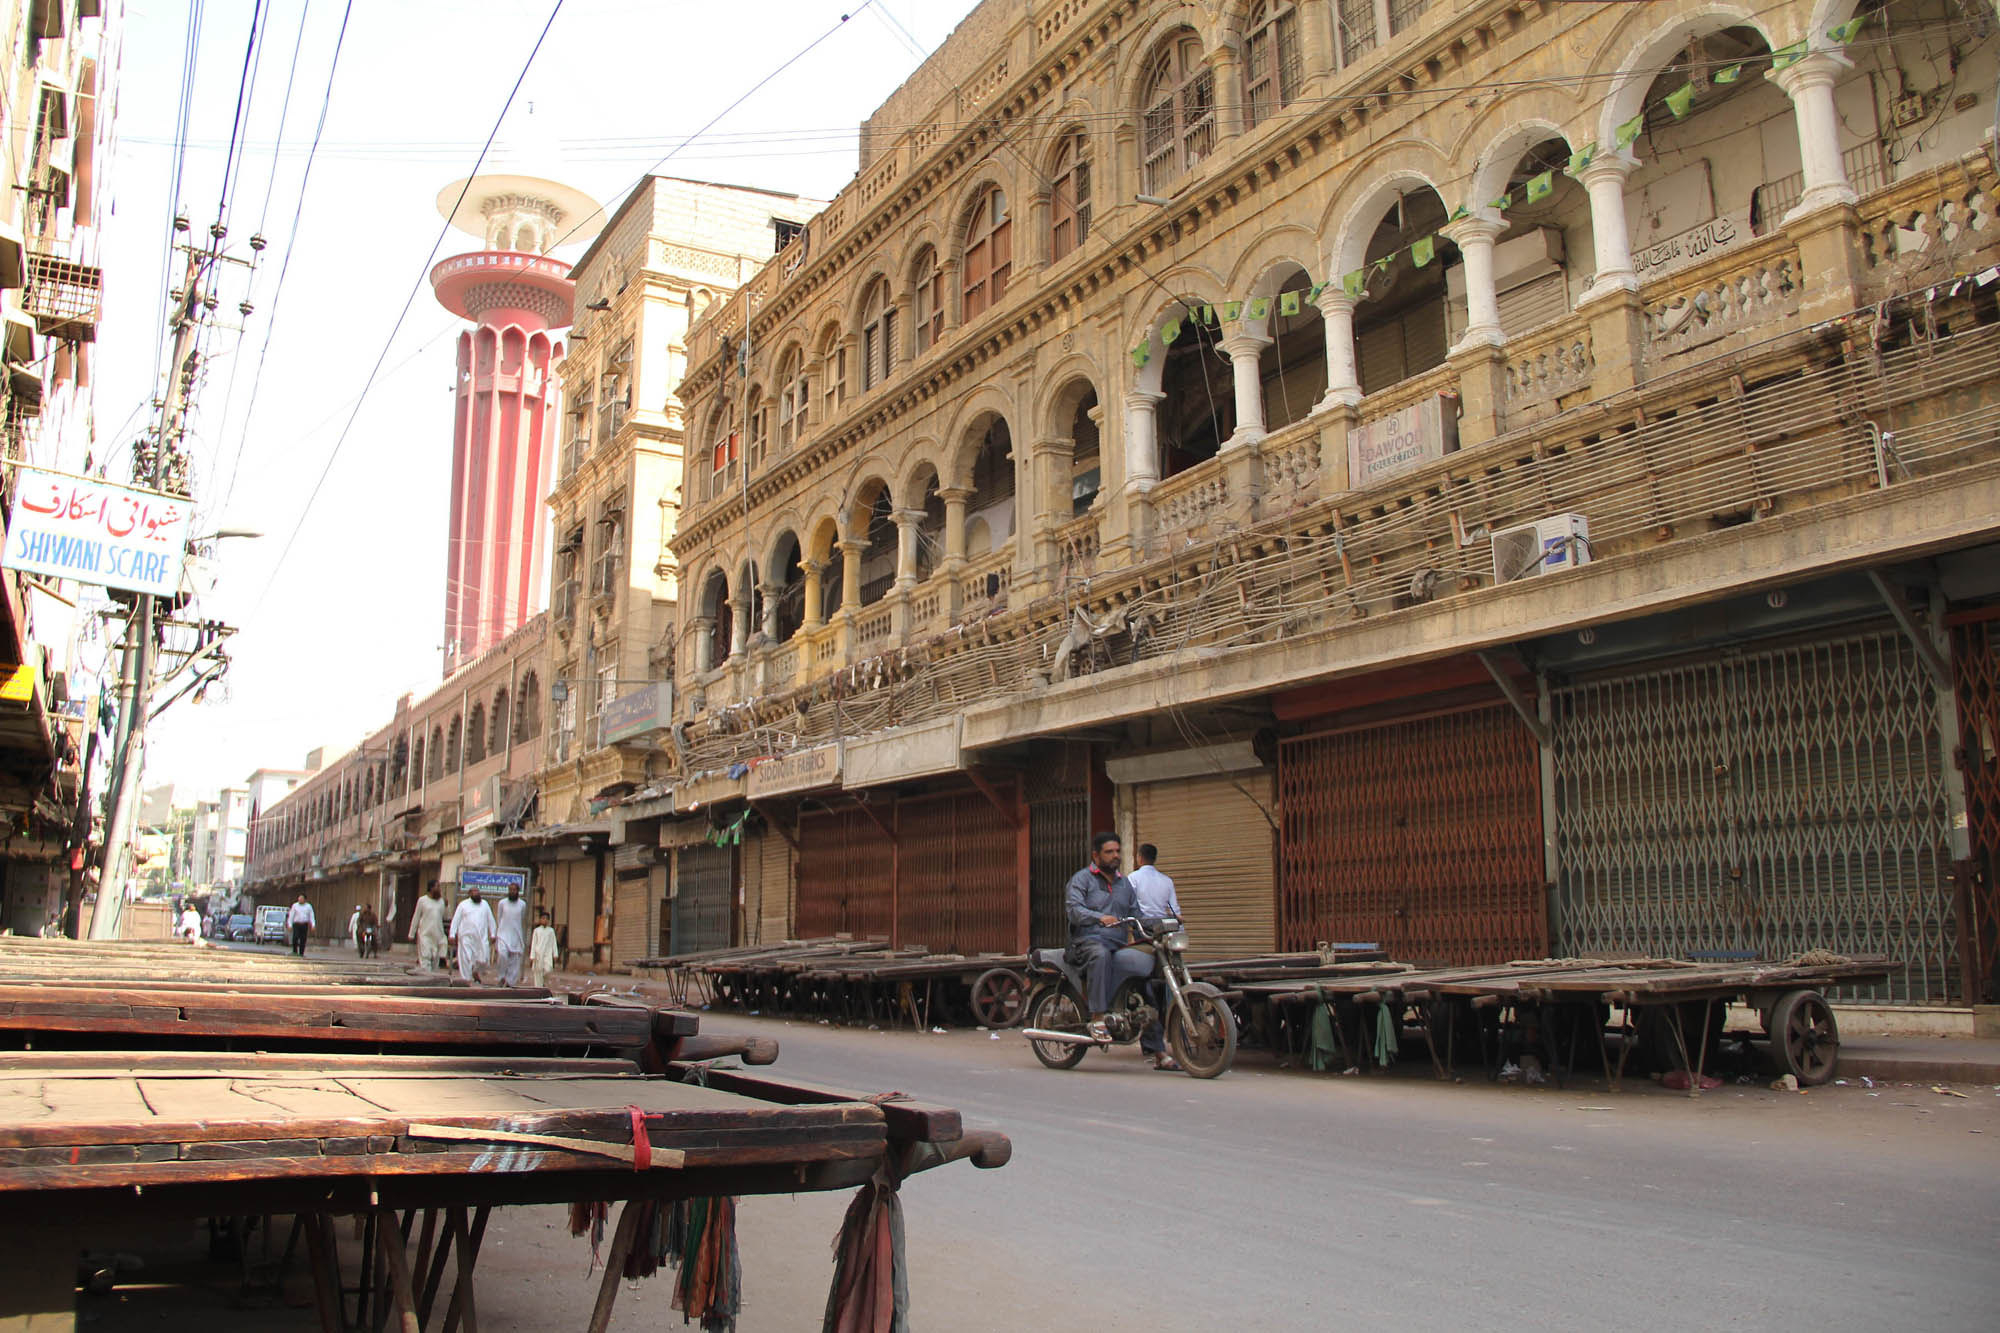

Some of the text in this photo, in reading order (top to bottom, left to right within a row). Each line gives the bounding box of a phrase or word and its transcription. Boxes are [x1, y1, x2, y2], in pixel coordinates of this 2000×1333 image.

[21, 484, 108, 524] اسکارف
[16, 529, 170, 583] SHIWANI SCARF
